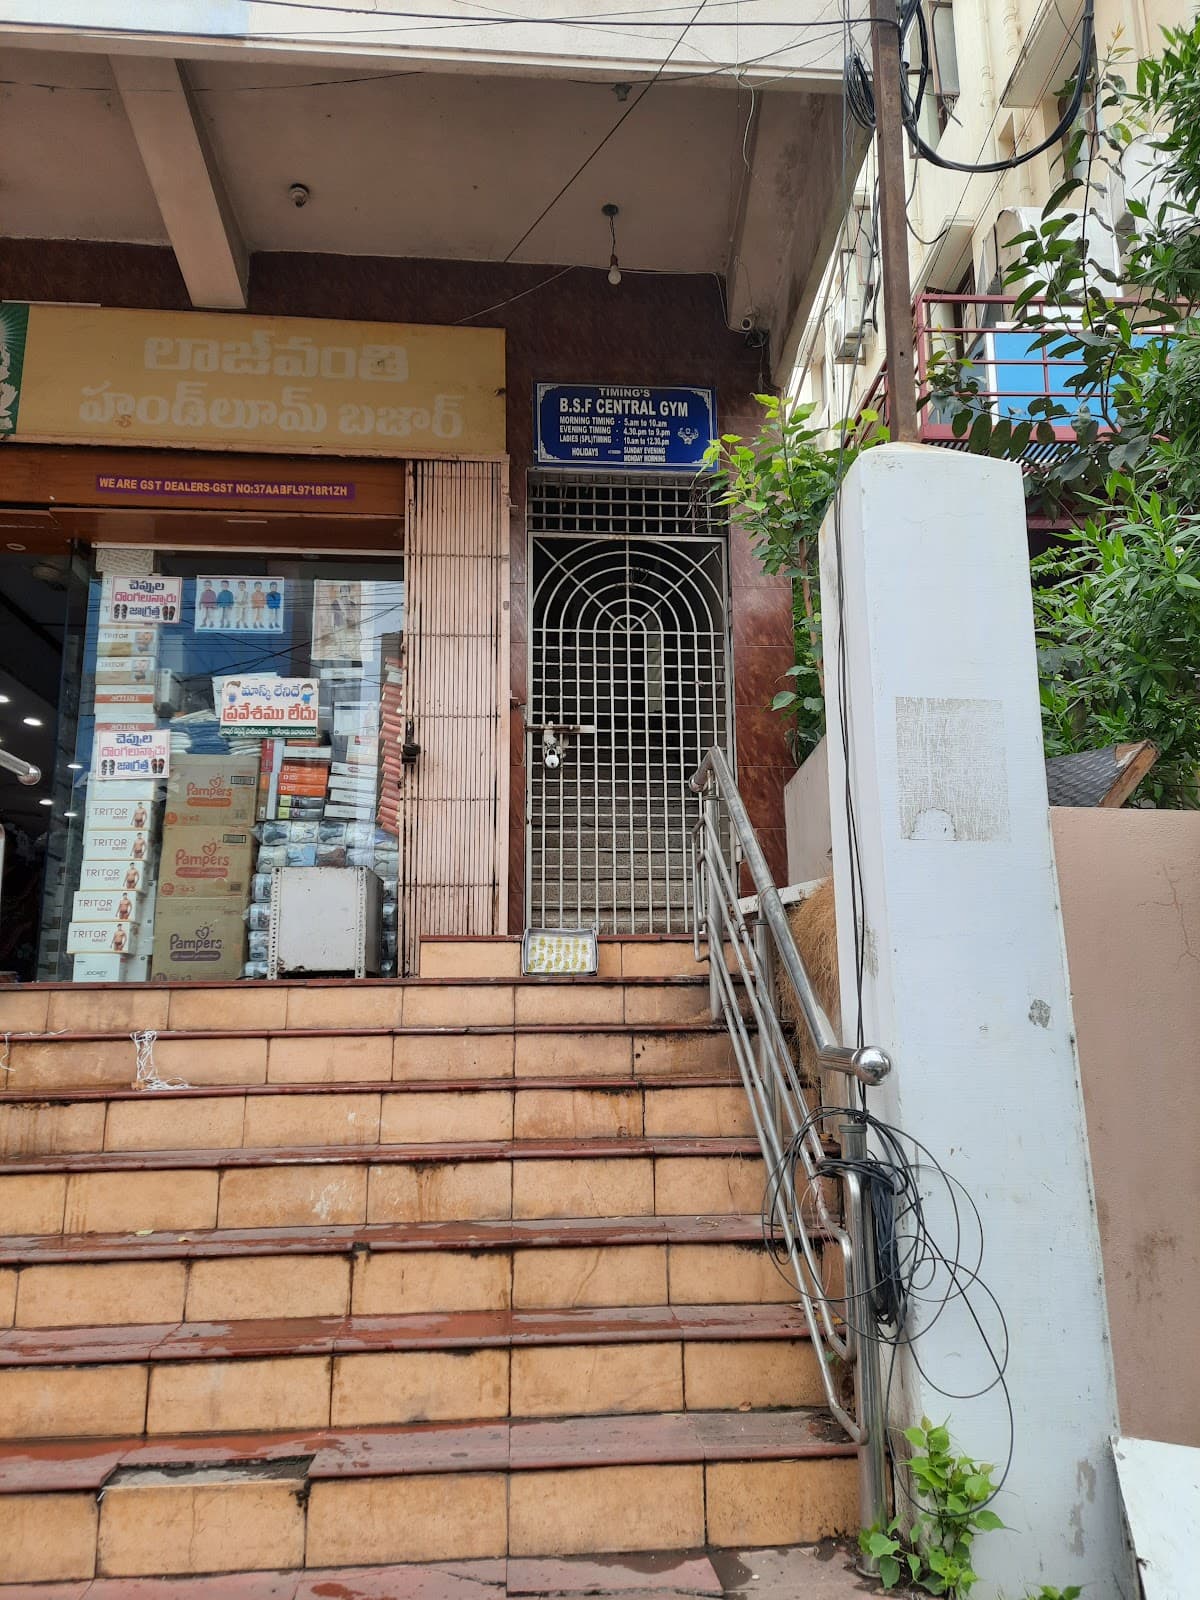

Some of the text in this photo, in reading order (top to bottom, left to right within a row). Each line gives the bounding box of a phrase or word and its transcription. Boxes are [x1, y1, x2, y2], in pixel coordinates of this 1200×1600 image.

[599, 387, 651, 398] TIMING'S
[559, 397, 688, 417] B.S.F CENTRAL GYM
[559, 415, 668, 428] MORNING TIMING 5.am to 10.am
[559, 425, 588, 434] EVENING
[589, 426, 611, 435] TIMING
[648, 428, 655, 436] to
[559, 434, 579, 443] LADIES
[640, 437, 646, 445] to
[571, 447, 599, 457] HOLIDAYS
[644, 447, 666, 455] EVENING
[623, 454, 666, 463] MONDAY MORNING
[99, 477, 115, 488] WE
[116, 478, 138, 490] ARE
[140, 479, 162, 491] GST
[164, 480, 233, 494] DEALERS-GST
[129, 579, 165, 594] చెప్పుల
[114, 590, 177, 605] దొంగలున్నారు
[128, 605, 161, 619] జాగ్రత్త
[223, 702, 317, 722] ప్రవేశము లేదు
[116, 733, 153, 746] చెప్పుల
[186, 781, 233, 800] Pampers
[93, 807, 129, 816] TRITOR
[92, 838, 128, 847] TRITOR
[175, 848, 230, 868] Pampers
[86, 868, 120, 877] TRITOR
[78, 899, 113, 908] TRITOR
[72, 930, 108, 939] TRITOR
[169, 932, 223, 952] Pampers
